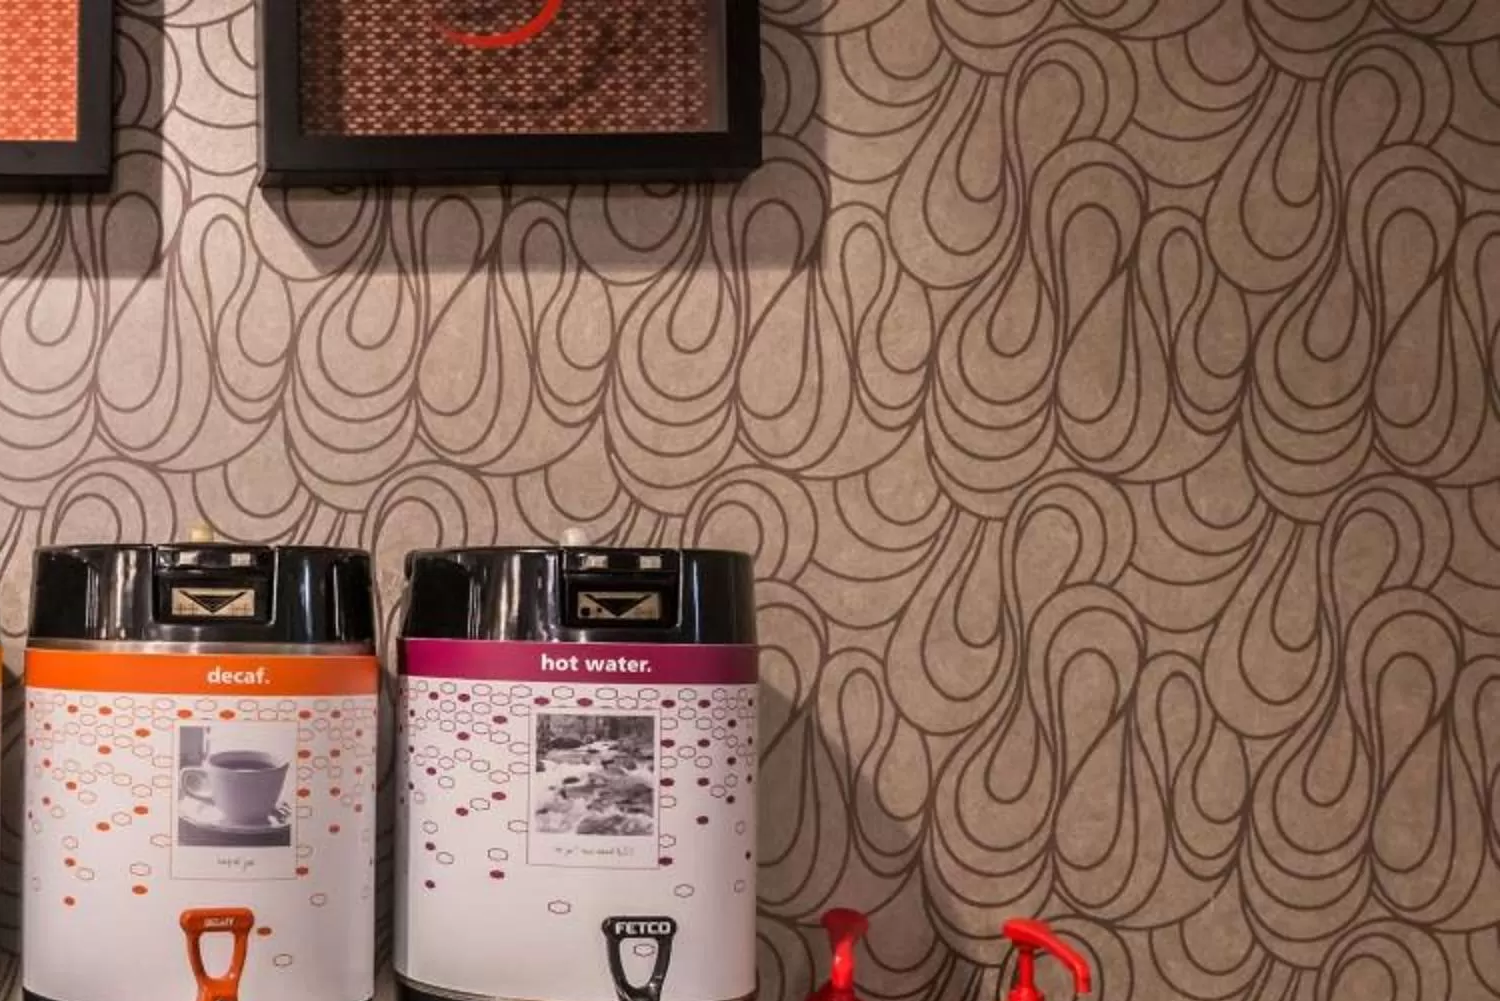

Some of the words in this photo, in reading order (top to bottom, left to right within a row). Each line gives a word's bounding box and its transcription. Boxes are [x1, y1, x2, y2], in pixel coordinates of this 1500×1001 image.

[541, 652, 579, 672] hot
[584, 656, 652, 673] water.
[206, 664, 271, 685] decaf.
[614, 921, 672, 935] FETCO
